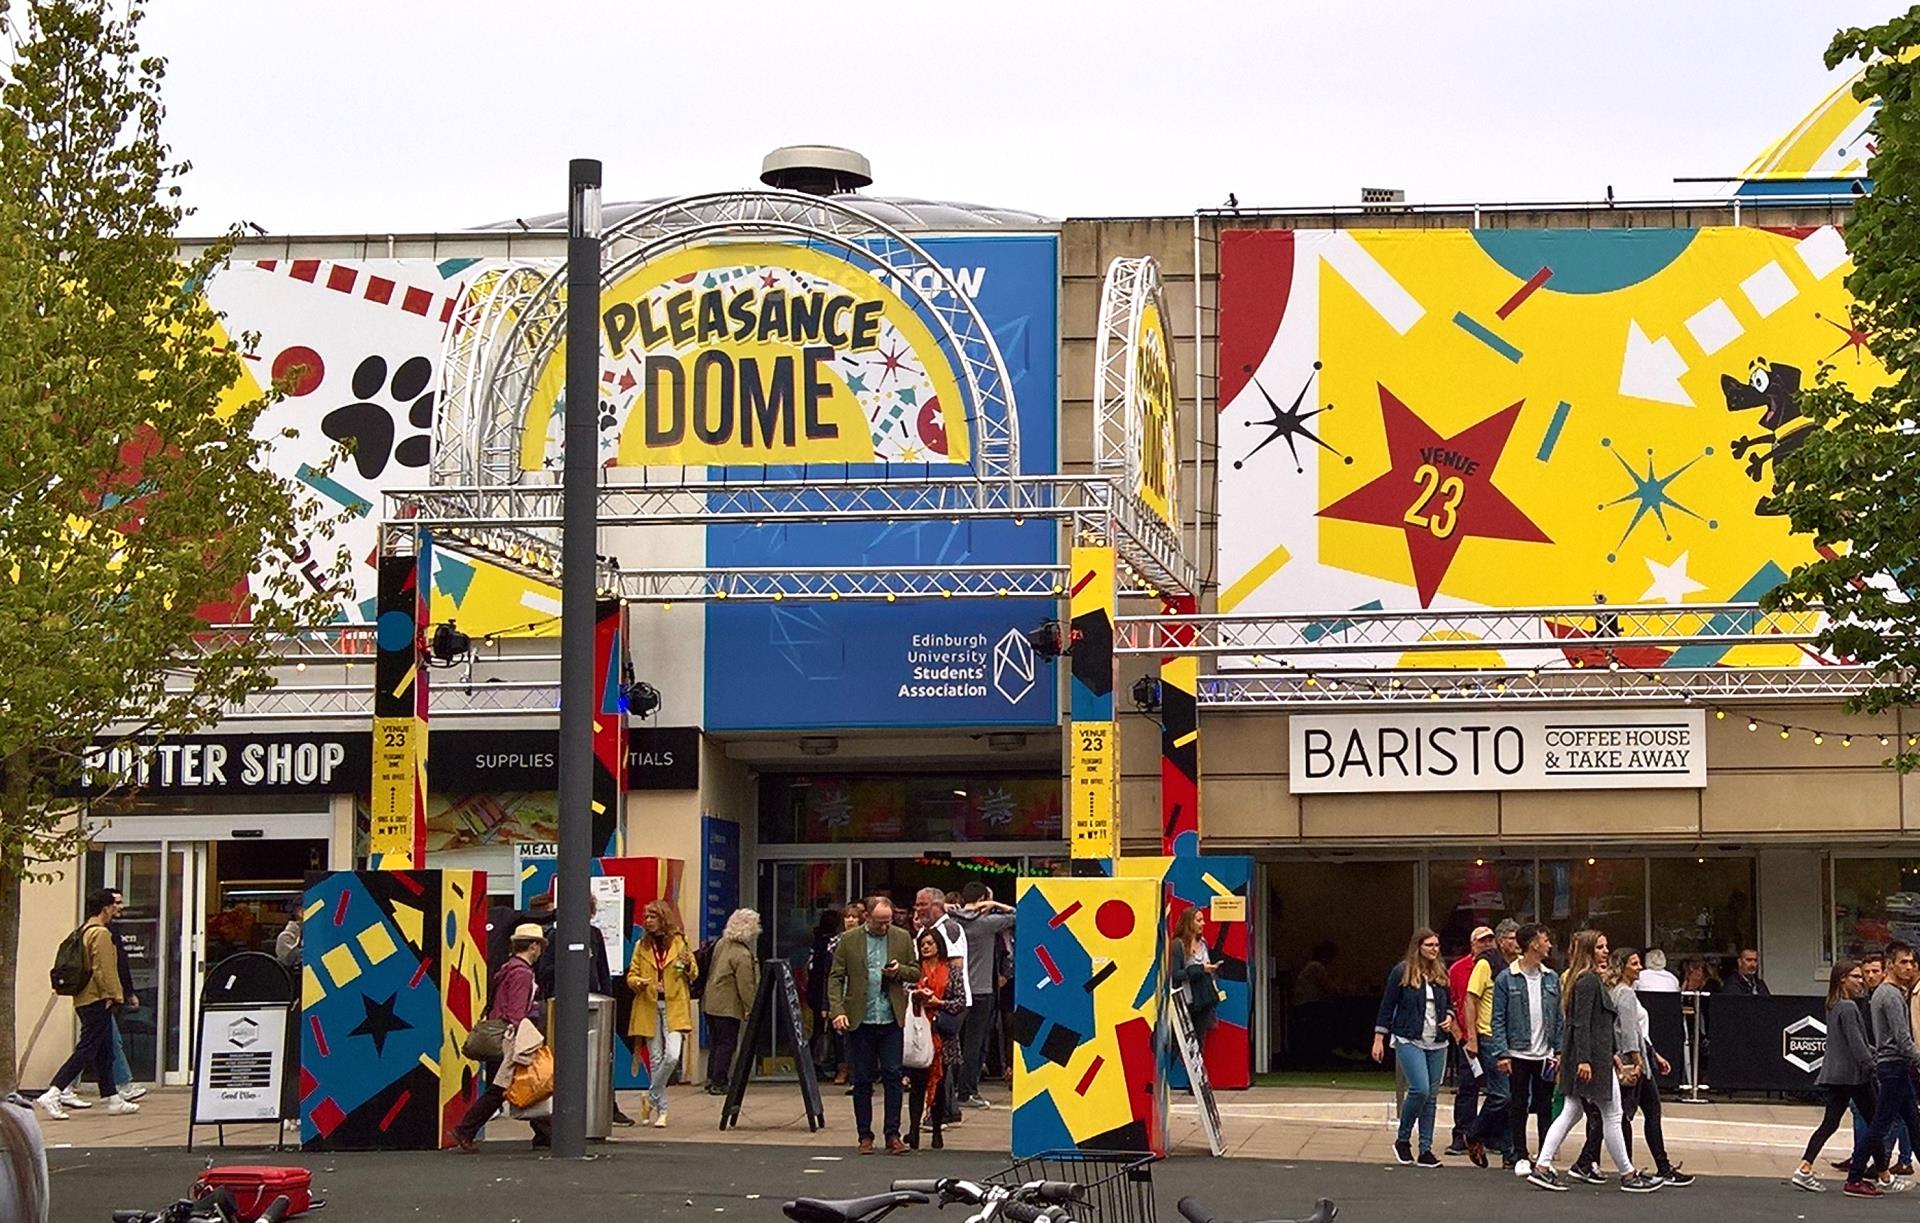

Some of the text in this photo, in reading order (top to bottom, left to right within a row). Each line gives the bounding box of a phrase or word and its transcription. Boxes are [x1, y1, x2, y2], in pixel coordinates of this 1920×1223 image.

[602, 288, 885, 357] PLEASANCE
[645, 346, 839, 449] DOME
[1419, 446, 1480, 476] VENUE
[1404, 463, 1465, 539] 23
[912, 633, 988, 649] Edinburgh
[907, 650, 988, 665] University
[913, 664, 988, 680] Students'
[898, 682, 988, 697] Association
[382, 725, 410, 733] VENUE
[1079, 729, 1107, 737] VENUE
[384, 733, 406, 747] 23
[1082, 737, 1104, 752] 23
[1545, 729, 1691, 747] COFFEE HOUSE
[475, 751, 674, 769] SUPPLIES TIALS
[1304, 725, 1525, 778] BARISTO
[1545, 750, 1691, 769] & TAKE AWAY
[81, 743, 345, 788] POTTER SHOP
[519, 843, 558, 856] MEAL
